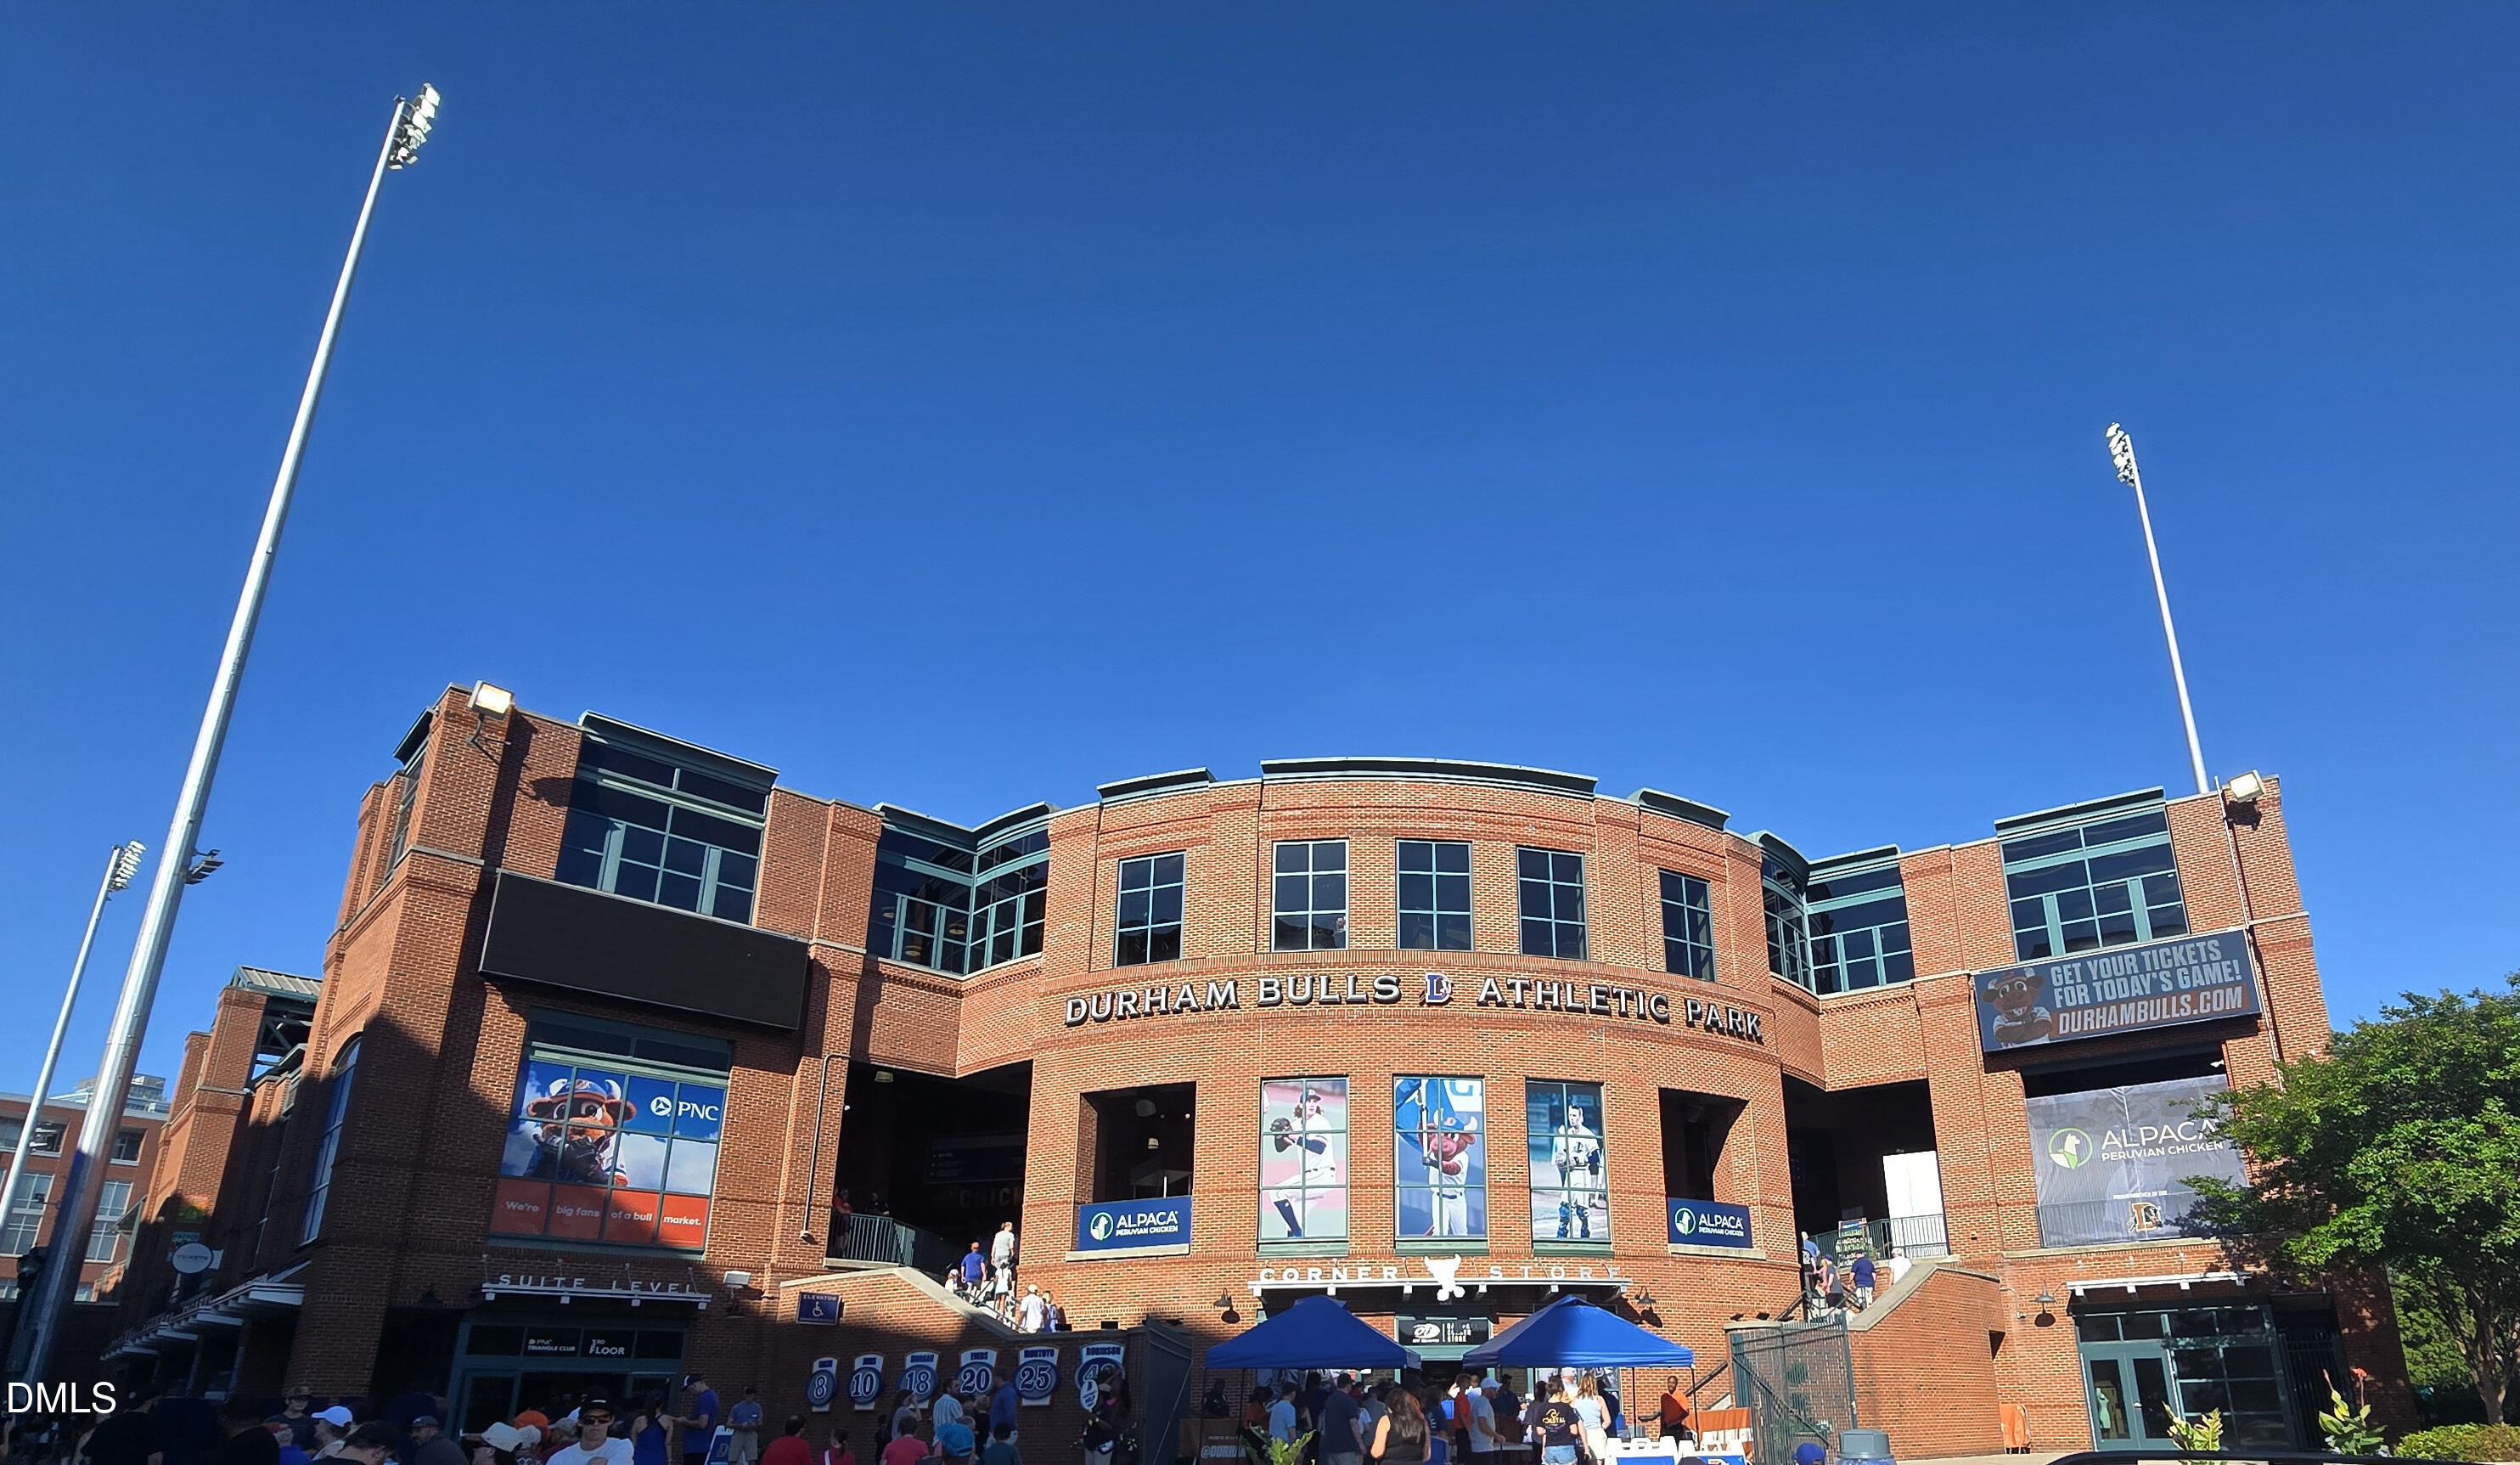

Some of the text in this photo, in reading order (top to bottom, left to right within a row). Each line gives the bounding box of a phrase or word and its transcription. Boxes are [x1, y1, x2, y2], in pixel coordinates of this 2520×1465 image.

[2050, 939, 2222, 987] GET YOUR TICKETS
[2054, 959, 2242, 1008] FOR TODAY'S GAME!
[1065, 978, 1240, 1027] DURHAM
[1257, 973, 1402, 1006] BULLS
[1477, 977, 1670, 1023] ATHLETIC
[1685, 997, 1764, 1045] PARK
[2058, 986, 2243, 1034] DURHAMBULLS.COM
[678, 1101, 720, 1121] PNC
[2101, 1118, 2218, 1150] ALPACA
[2101, 1141, 2224, 1162] PERUVIAN CHICKEN
[505, 1200, 540, 1213] We're
[556, 1205, 576, 1220] big
[577, 1207, 600, 1218] fans
[610, 1209, 622, 1220] of
[633, 1211, 653, 1222] bull
[663, 1215, 701, 1226] market.
[1117, 1211, 1178, 1228] ALPACA
[1699, 1214, 1743, 1230] ALPACA
[1116, 1225, 1178, 1237] PERUVIAN CHICKEN
[498, 1274, 697, 1295] SUITE LEVEL
[1259, 1265, 1621, 1282] CORNER STORE
[589, 1344, 625, 1355] FLOOR
[814, 1375, 828, 1398] 8
[851, 1372, 876, 1397] 10
[906, 1369, 931, 1395] 18
[960, 1366, 993, 1393] 20
[1020, 1365, 1052, 1391] 25
